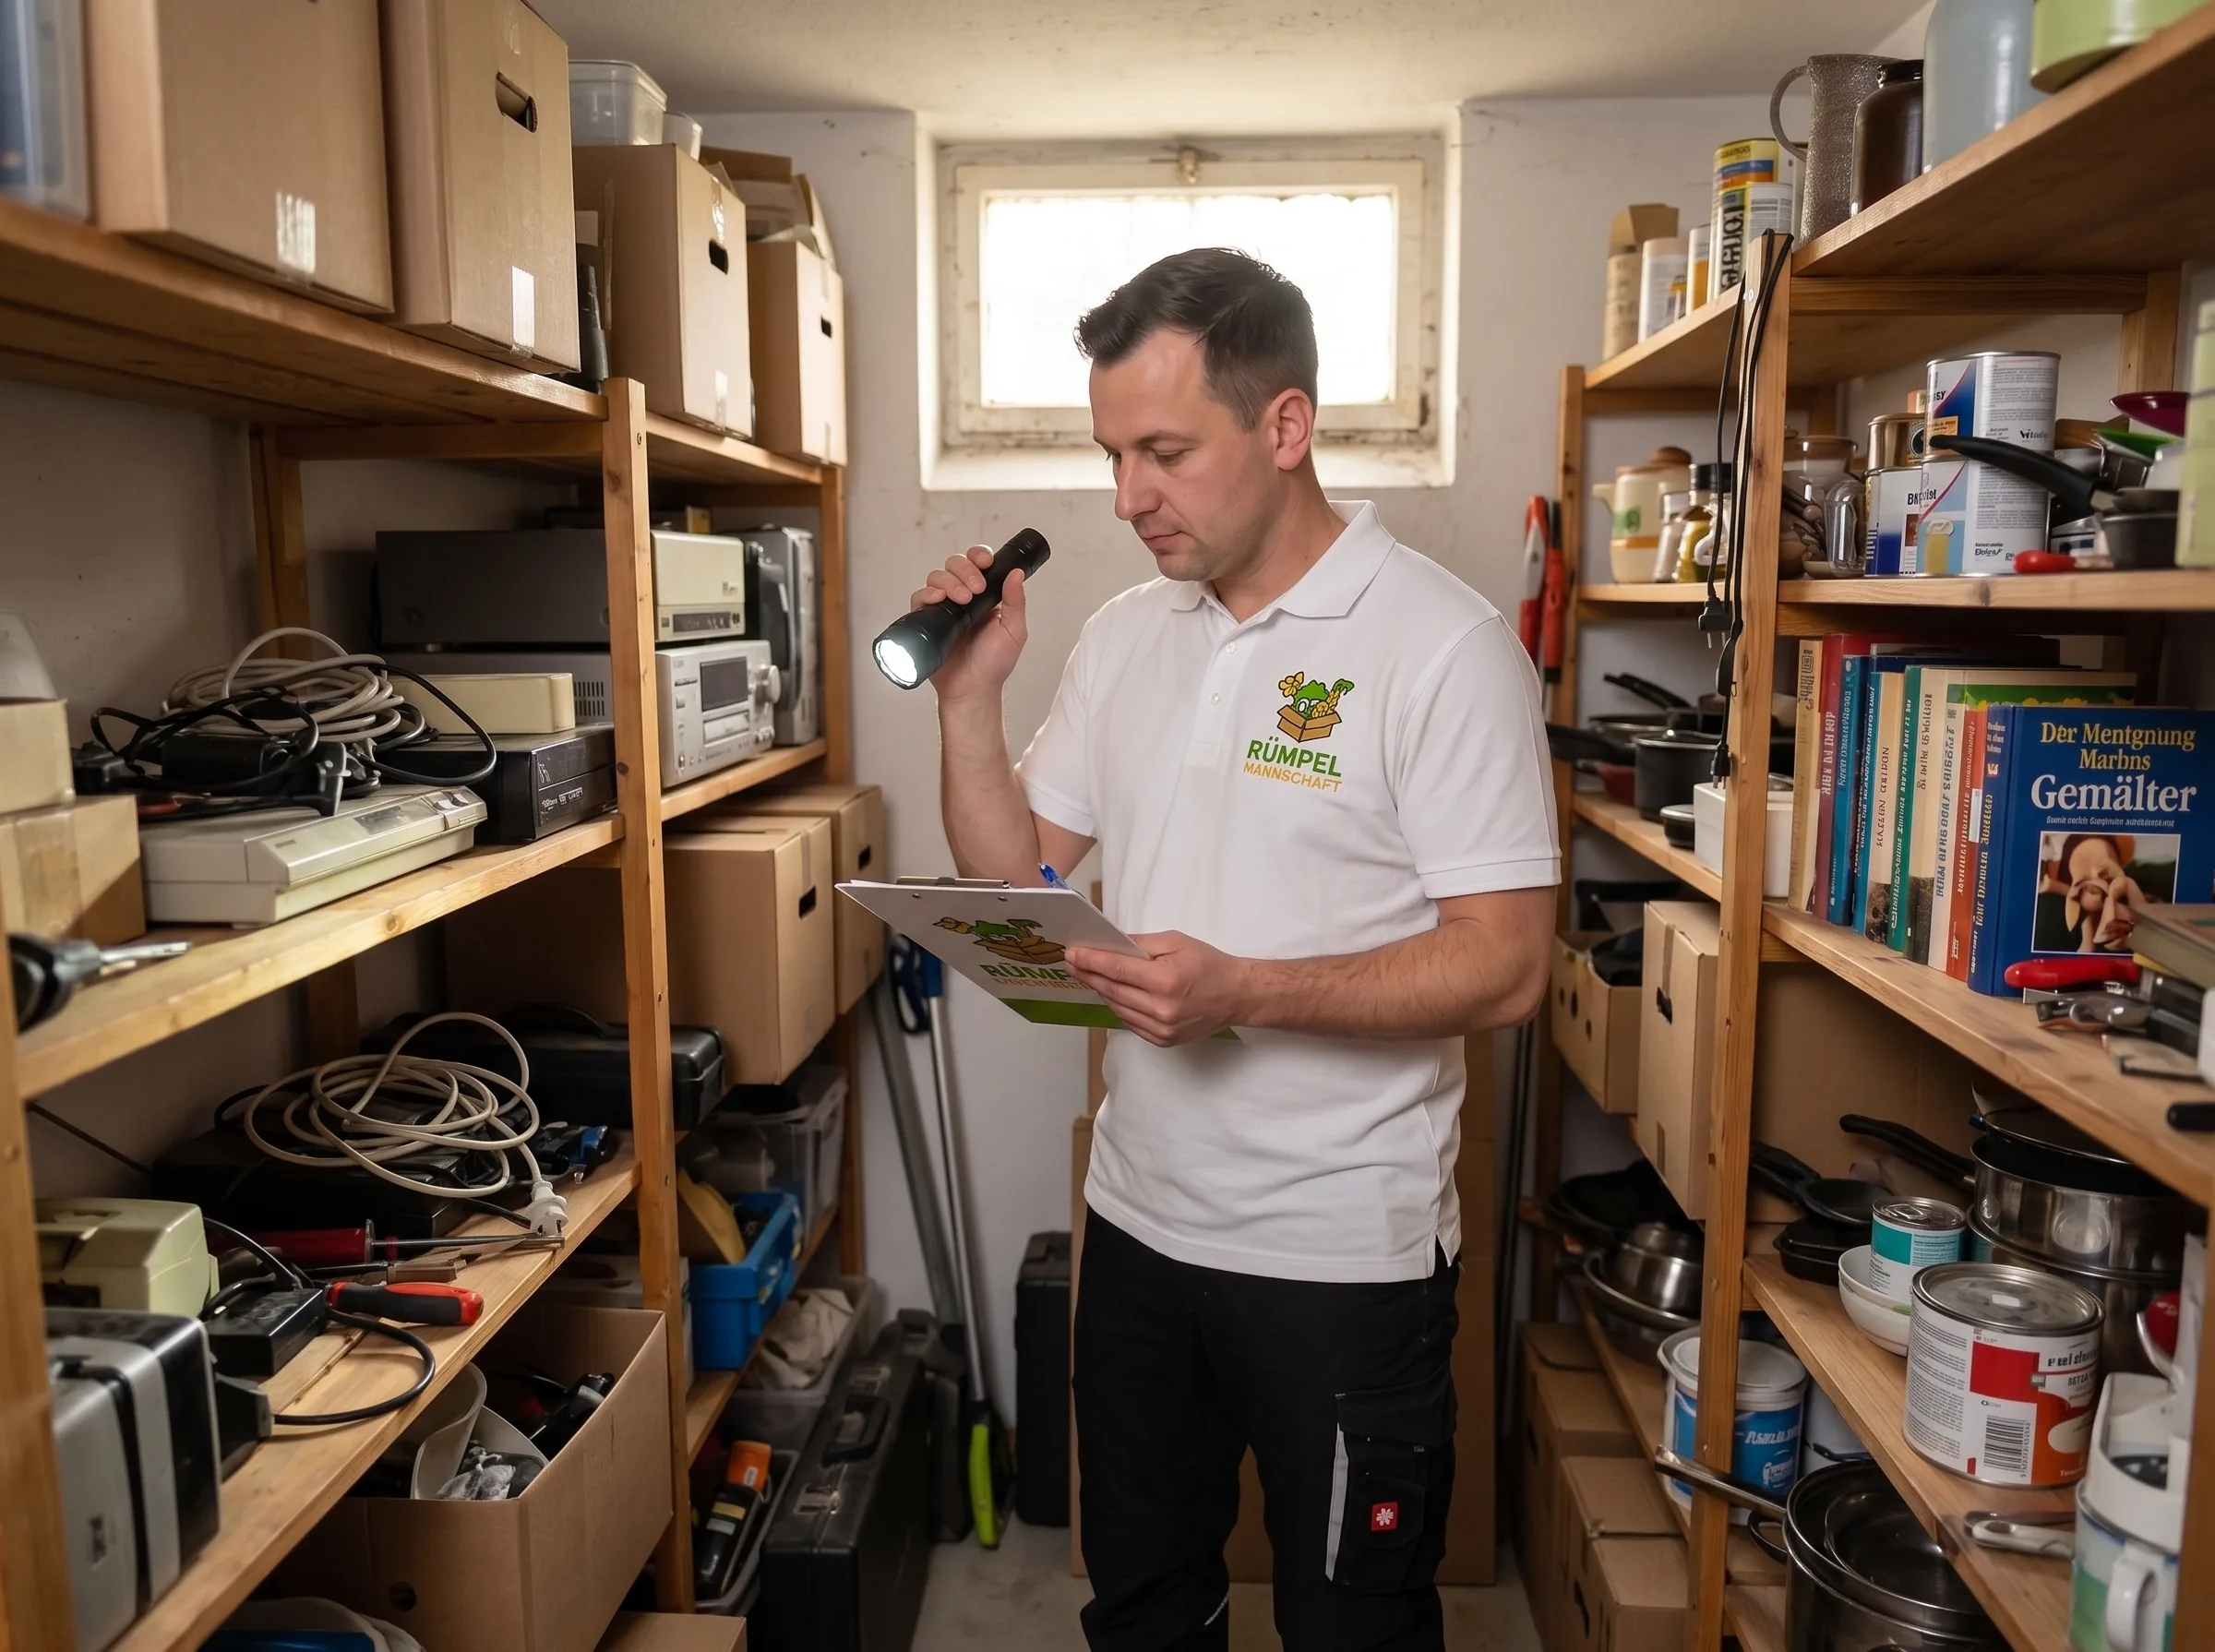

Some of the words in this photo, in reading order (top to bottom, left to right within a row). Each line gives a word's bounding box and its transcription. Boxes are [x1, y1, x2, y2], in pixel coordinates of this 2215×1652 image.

[1247, 736, 1342, 777] RÜMPEL
[1243, 761, 1343, 793] MANNSCHAFT
[2030, 773, 2197, 812] Gemälter
